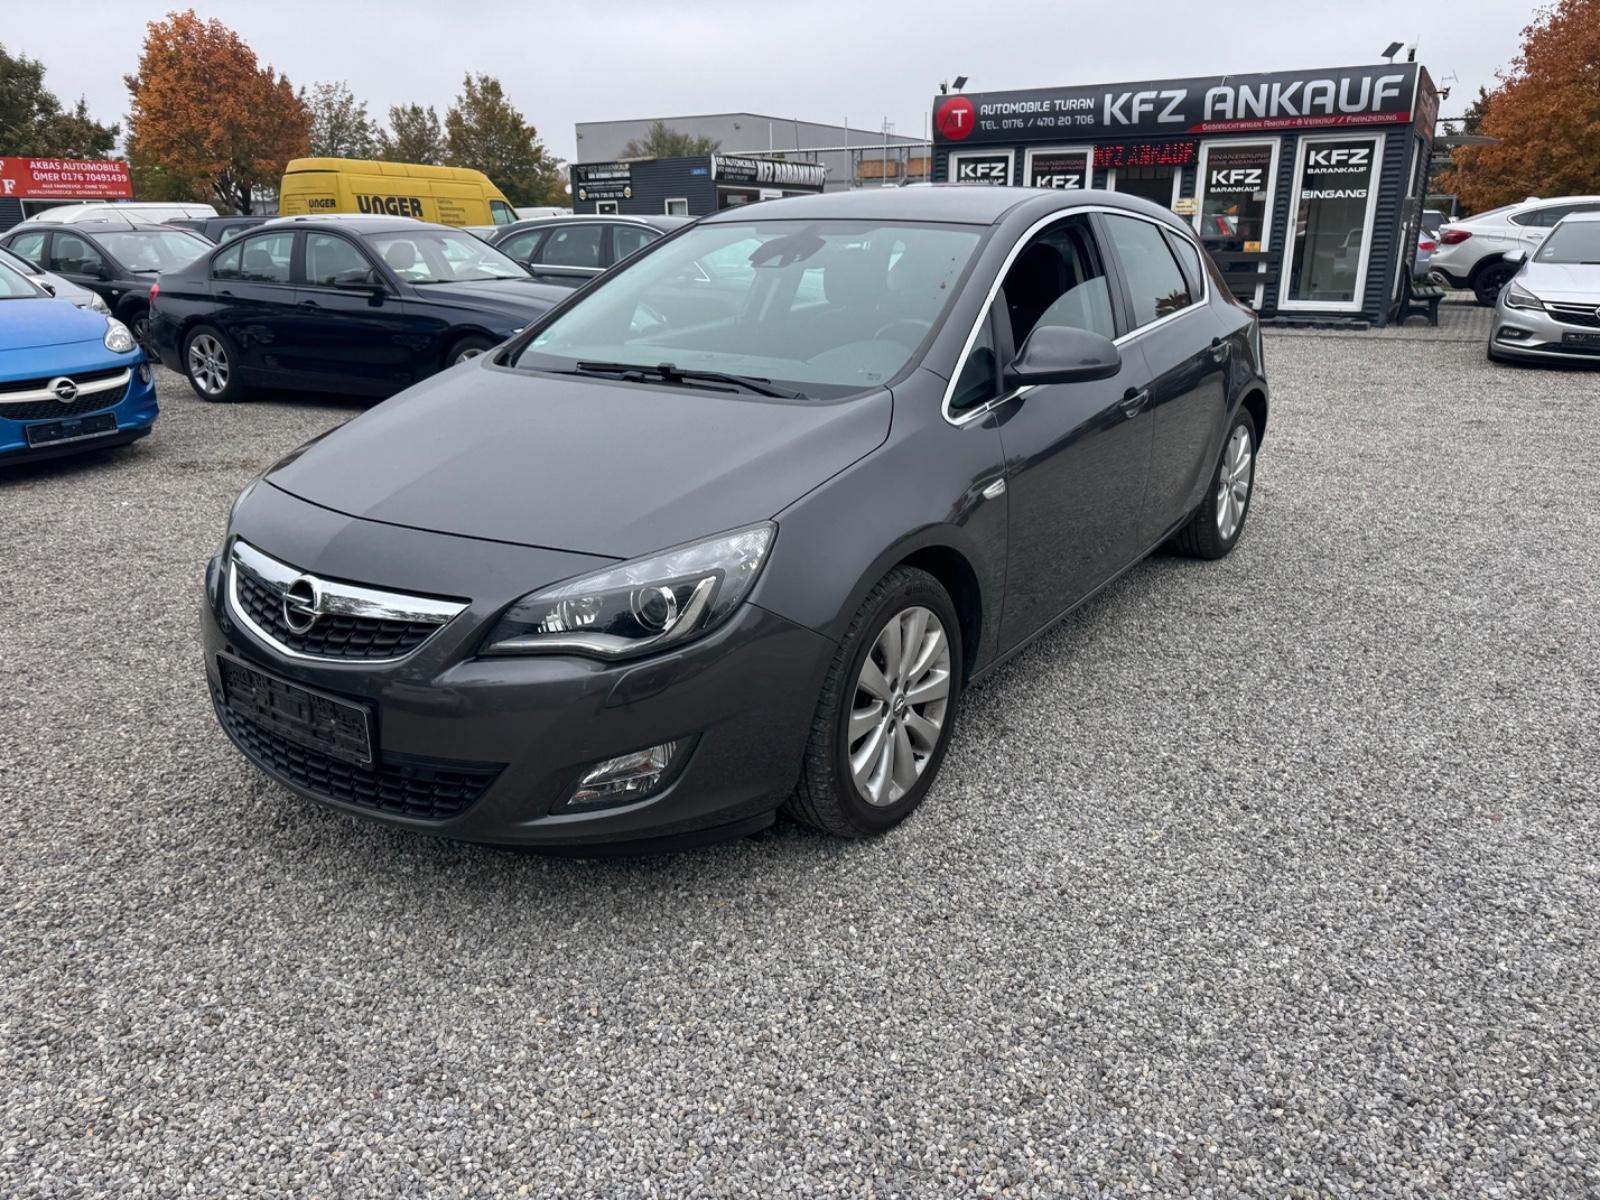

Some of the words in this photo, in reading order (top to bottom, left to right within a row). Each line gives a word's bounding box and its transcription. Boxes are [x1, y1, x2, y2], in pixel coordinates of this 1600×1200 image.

[980, 102, 1050, 115] AUTOMOBILE
[1054, 98, 1095, 111] TURAN
[1103, 89, 1188, 126] KFZ
[1204, 75, 1405, 121] ANKAUF
[980, 121, 1000, 131] TEL.
[1002, 118, 1024, 129] 0176
[1037, 116, 1054, 127] 470
[1058, 115, 1072, 126] 20
[1074, 114, 1095, 125] 706
[1308, 148, 1370, 166] KFZ
[30, 161, 60, 170] AKBAS
[63, 162, 120, 171] AUTOMOBILE
[961, 162, 1005, 177] KFZ
[1307, 166, 1368, 174] BARANKAUF
[33, 171, 59, 181] ÖMER
[61, 172, 84, 181] 0176
[85, 173, 127, 182] 70491439
[1036, 175, 1080, 189] KFZ
[1211, 168, 1262, 185] KFZ
[1302, 189, 1368, 199] EINGANG
[309, 198, 336, 208] UNGER
[356, 195, 424, 217] UNGER
